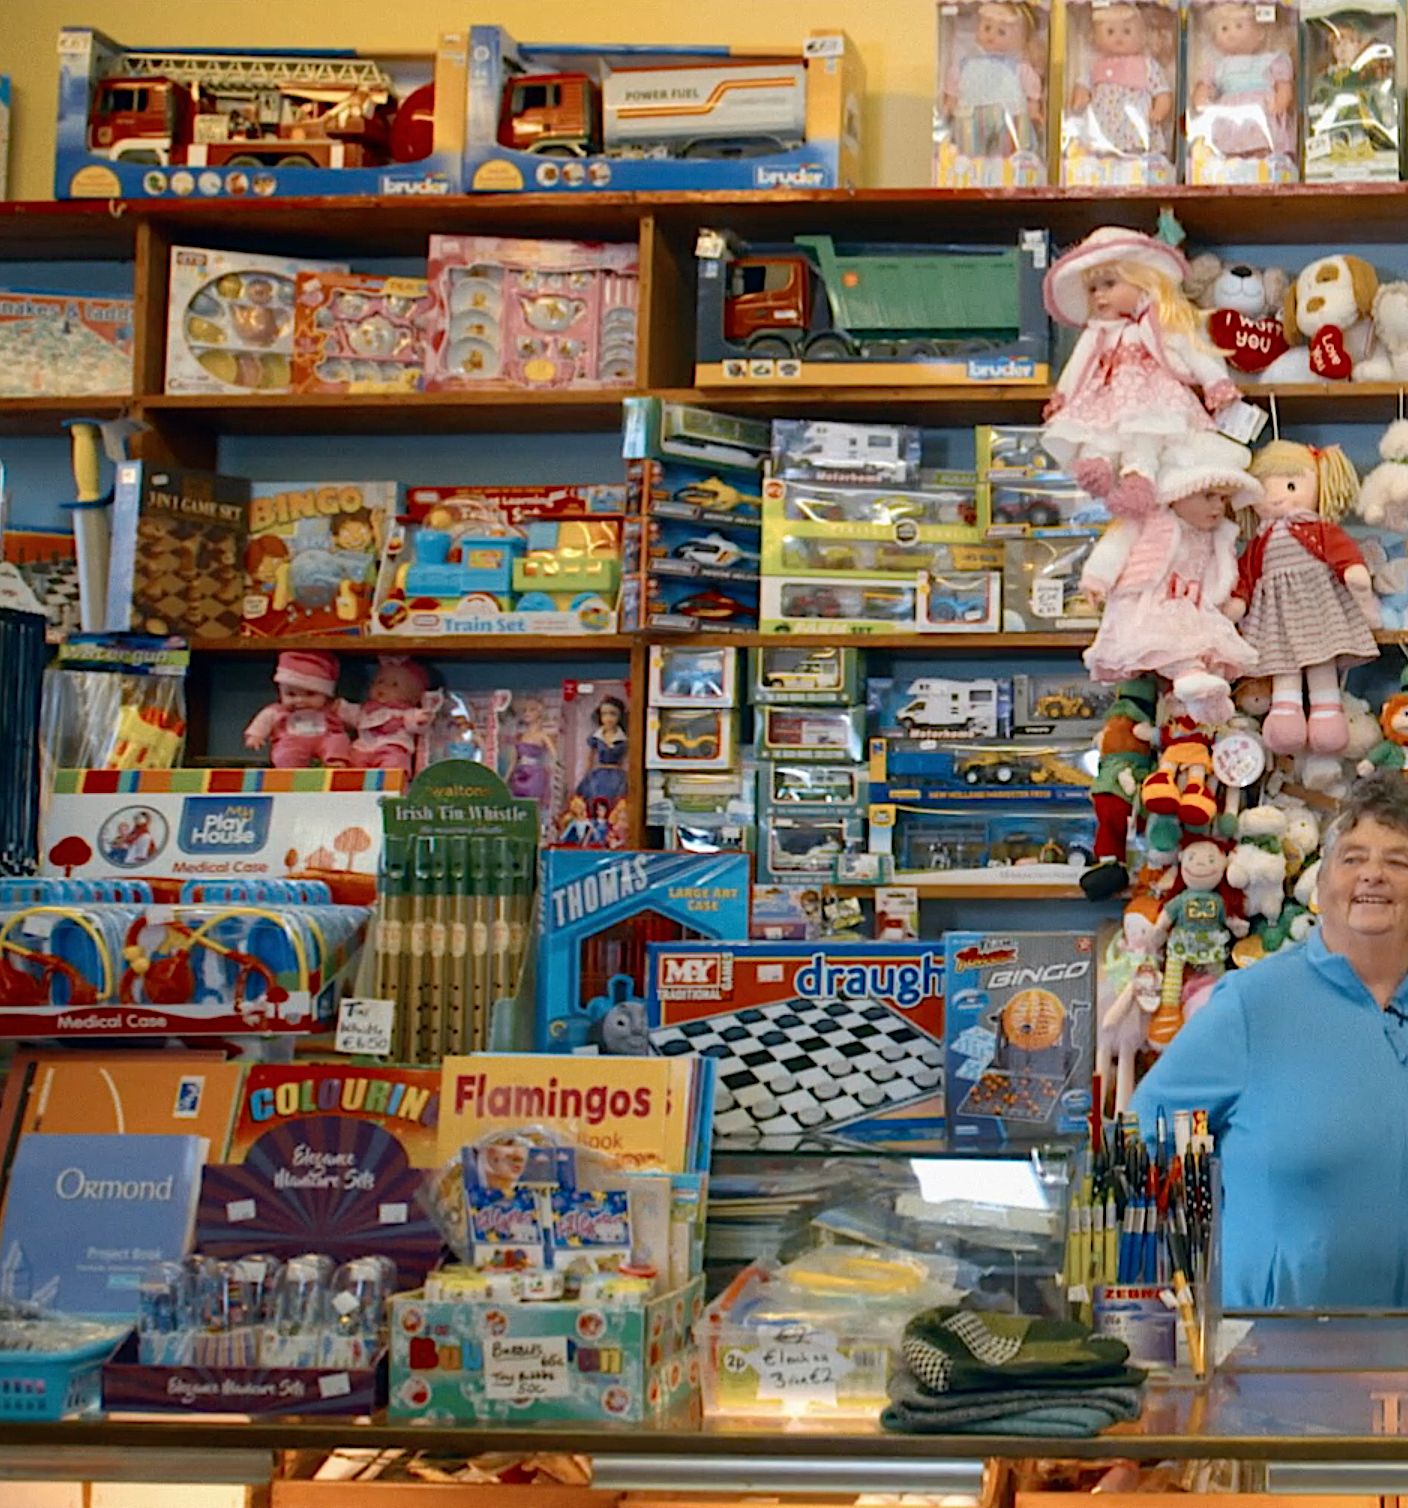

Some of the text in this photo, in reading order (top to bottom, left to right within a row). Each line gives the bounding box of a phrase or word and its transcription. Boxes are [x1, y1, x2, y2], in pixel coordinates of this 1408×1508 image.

[625, 87, 700, 102] POWER FUEL
[383, 174, 449, 194] bruder
[756, 167, 824, 187] bruder
[1, 303, 57, 320] nakes
[83, 304, 133, 320] ladd
[968, 359, 1034, 378] bruder
[250, 486, 364, 536] BINGO
[443, 617, 526, 633] Train Set
[226, 803, 254, 823] My
[395, 804, 528, 823] Irish Tin Whistle
[204, 813, 247, 837] Play
[190, 827, 256, 846] House
[171, 860, 269, 874] Medical Case
[552, 852, 649, 930] THOMAS
[796, 952, 946, 1009] draugh
[986, 960, 1092, 990] BINGO
[57, 1013, 168, 1030] Medical Case
[250, 1077, 440, 1122] COLOURIN
[455, 1073, 652, 1127] Flamingos
[56, 1167, 173, 1201] Ormond
[727, 1352, 746, 1371] 2p
